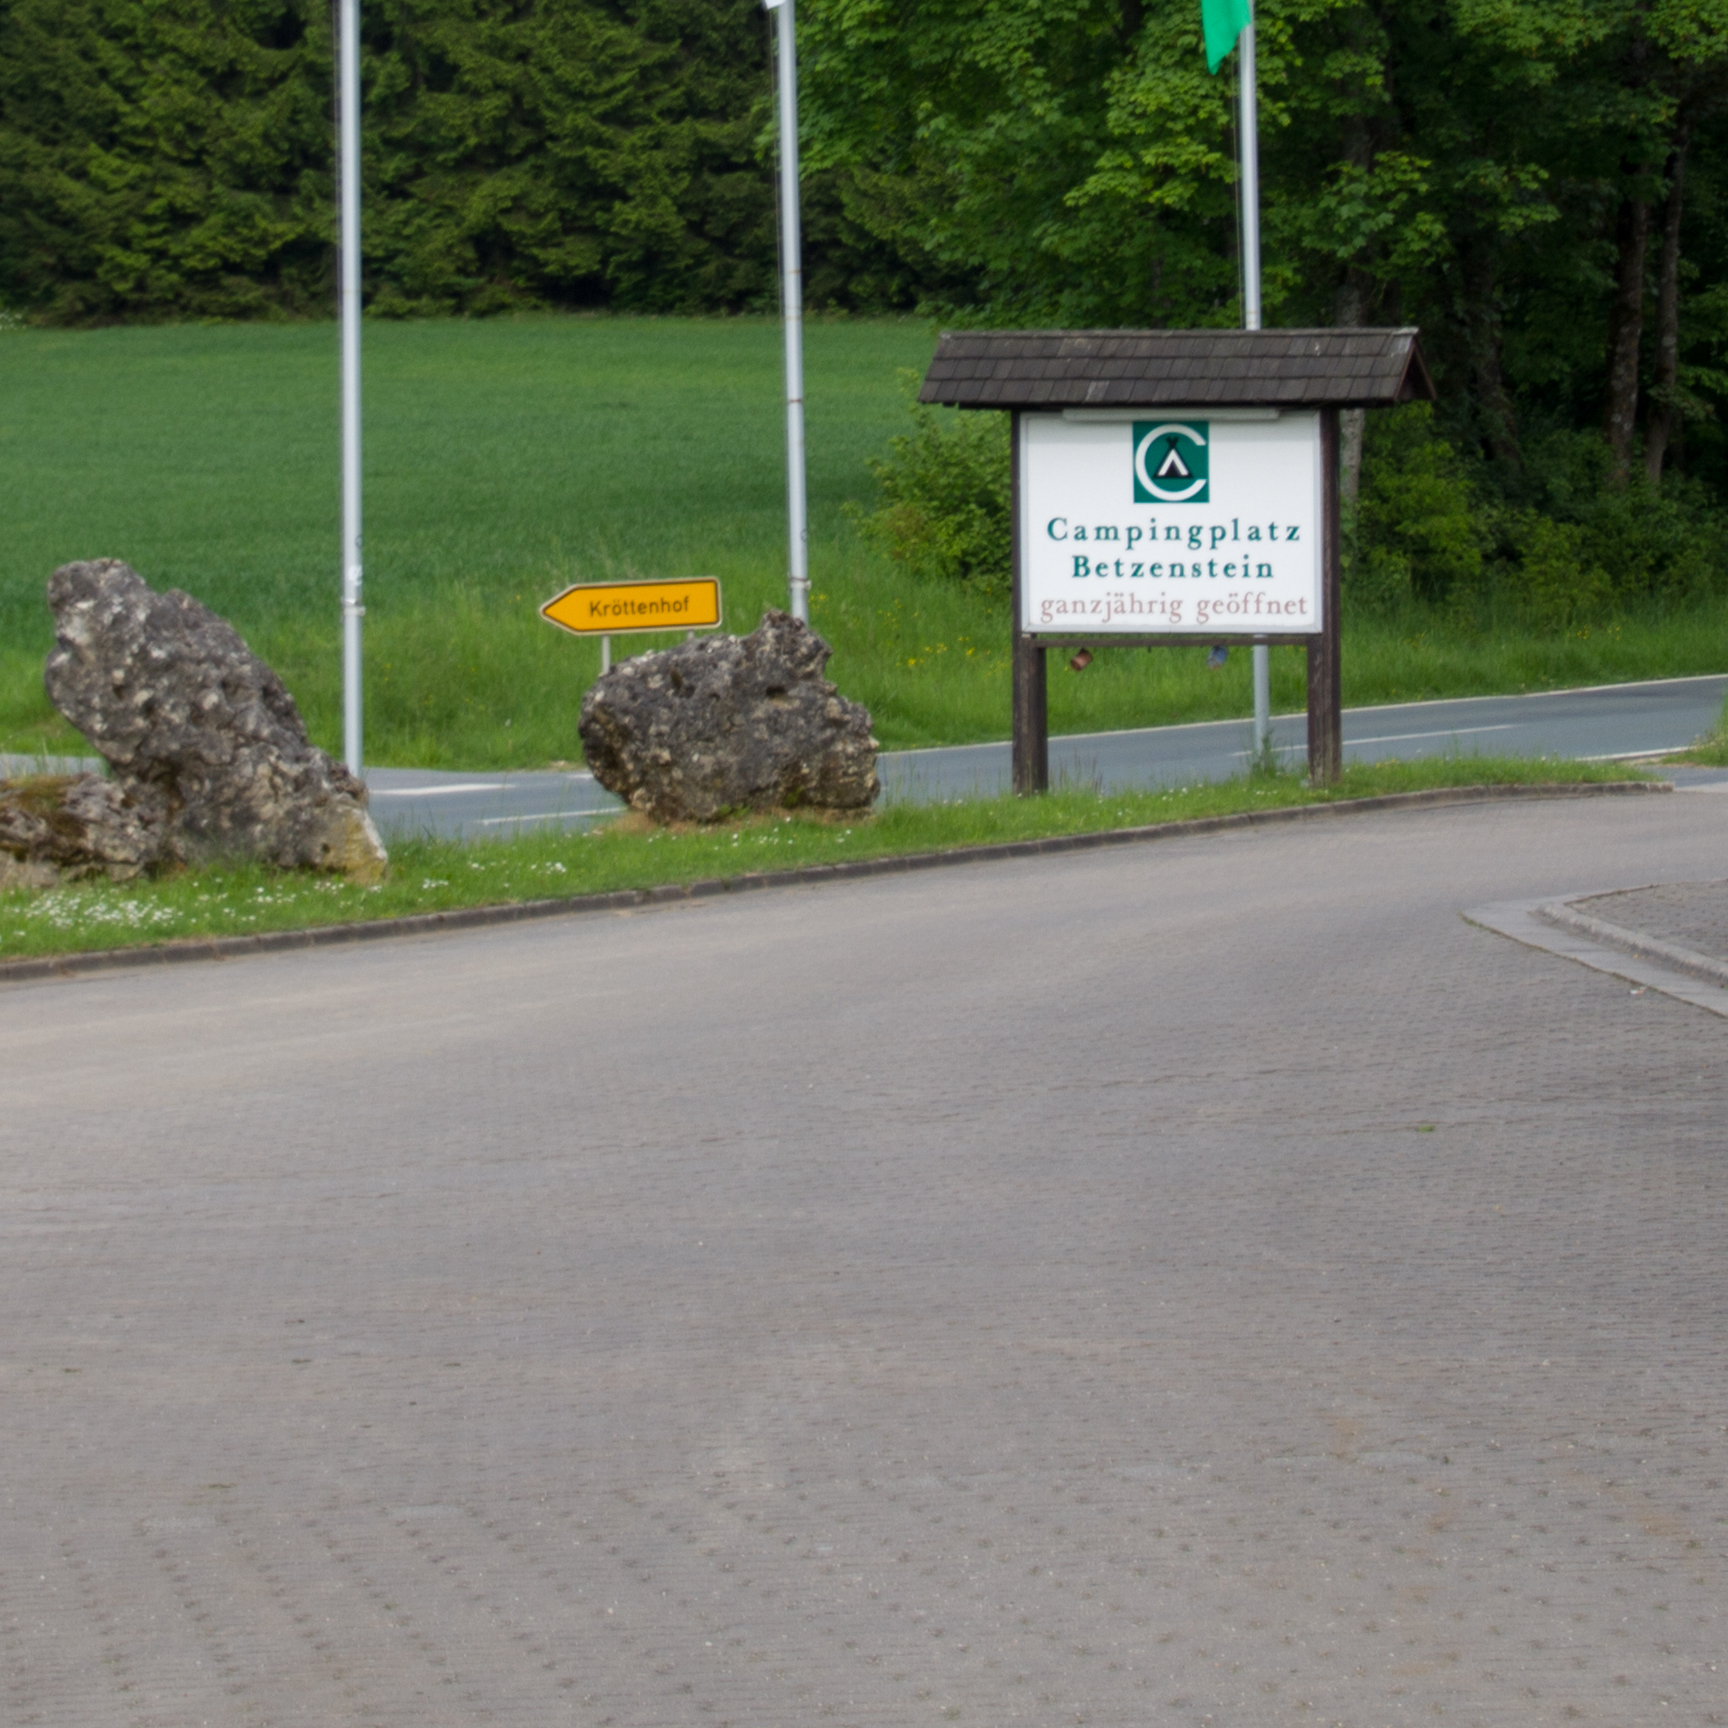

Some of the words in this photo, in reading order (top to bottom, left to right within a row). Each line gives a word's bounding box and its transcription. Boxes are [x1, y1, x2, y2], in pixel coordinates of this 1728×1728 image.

[1047, 517, 1301, 550] Campingplatz
[1071, 554, 1274, 578] Betzenstein
[589, 595, 689, 617] Kröttenhof
[1040, 591, 1183, 623] ganzjährig
[1196, 591, 1307, 624] geöffnet
